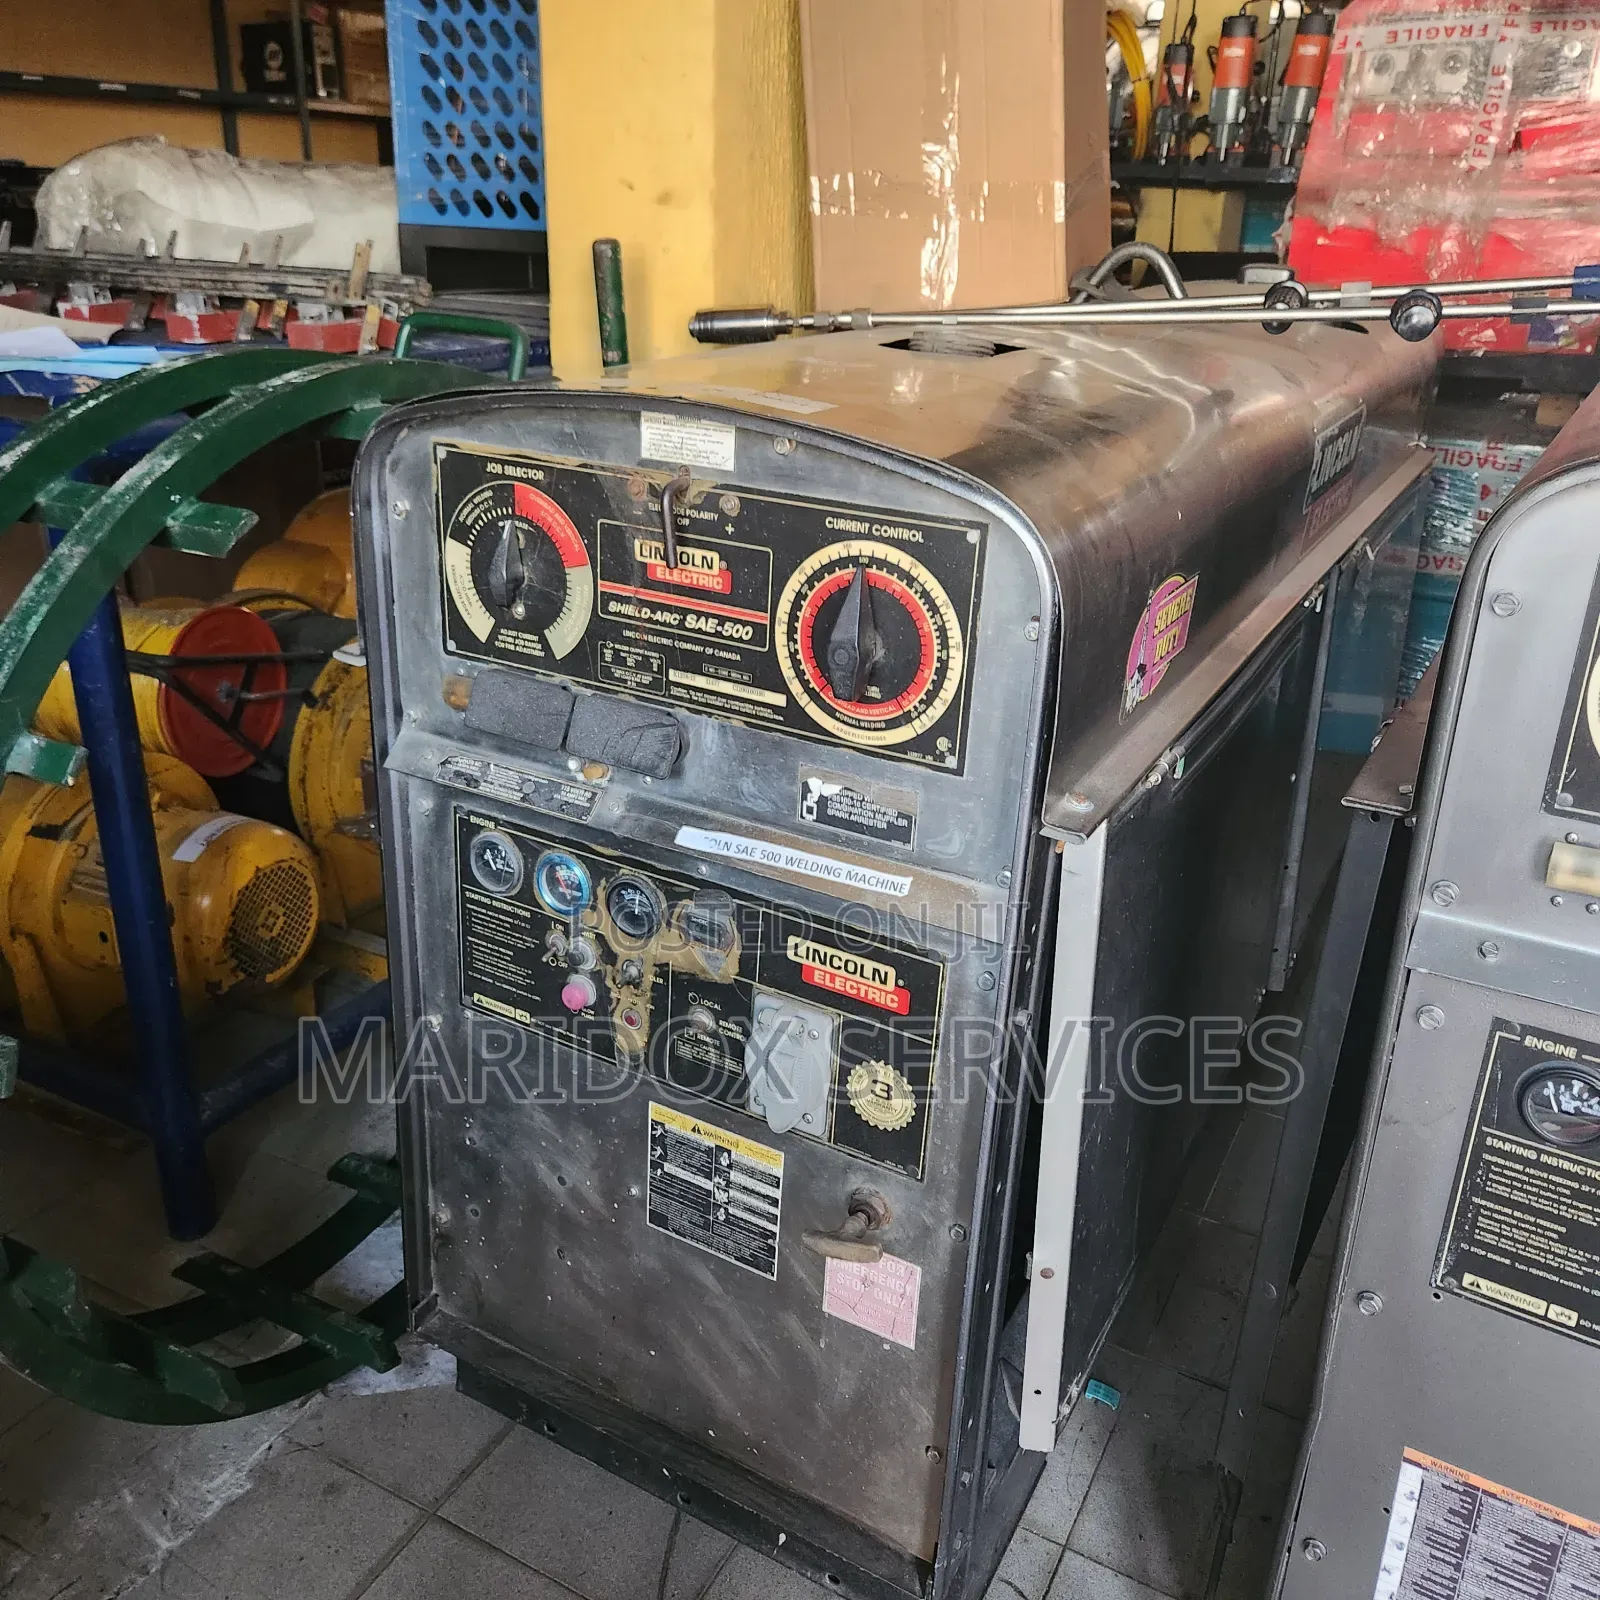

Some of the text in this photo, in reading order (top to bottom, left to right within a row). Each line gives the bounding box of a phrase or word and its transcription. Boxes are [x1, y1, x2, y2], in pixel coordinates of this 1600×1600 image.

[1386, 24, 1488, 44] FRAGILE
[1472, 63, 1507, 159] FRAGILE
[486, 462, 545, 480] JOB SELECTOR
[676, 516, 690, 527] OFF
[686, 508, 719, 522] POLARITY
[826, 517, 924, 543] CURRENT CONTROL
[638, 542, 715, 571] LINOLN
[655, 567, 724, 590] ELECTRIC
[1154, 588, 1194, 637] SEVERE
[684, 613, 754, 642] SAE-500
[648, 634, 673, 646] ELECTRIC
[674, 640, 704, 654] COMPANY
[704, 646, 714, 655] OF
[714, 648, 742, 662] CANADA
[1154, 625, 1183, 666] DUTY
[835, 711, 886, 729] NORMAL WELDING
[826, 808, 887, 830] SPARK ARRESTER
[828, 800, 908, 828] COMBINATION MUFFLER
[862, 801, 898, 816] CERTIFIED
[470, 816, 496, 830] ENGINE
[734, 841, 756, 859] SAE
[759, 849, 782, 864] 500
[784, 856, 842, 879] WELDING
[844, 869, 908, 894] MACHINE
[464, 891, 531, 918] STARTING INSTRUCTIONS
[556, 924, 564, 932] ON
[792, 942, 890, 986] LINCOLN
[813, 970, 899, 1008] ELECTRIC
[484, 1000, 513, 1014] WARNING
[700, 998, 722, 1010] LOCAL
[718, 1020, 744, 1033] REMOTE
[718, 1027, 746, 1042] CONTRO
[697, 1034, 721, 1046] REMOTE
[1524, 1035, 1578, 1059] ENGINE
[870, 1079, 894, 1101] 3
[702, 1128, 740, 1149] WARNING
[1485, 1136, 1538, 1160] STARTING
[1482, 1152, 1524, 1172] TEMPERATURE
[1524, 1167, 1548, 1179] ABOVE
[1548, 1174, 1580, 1189] FREEZING
[1472, 1196, 1566, 1234] TEMPERATURE BELOW FREEZING
[833, 1258, 912, 1296] EMERGENCY
[880, 1260, 906, 1278] FOR
[1460, 1242, 1470, 1250] TO
[1470, 1246, 1487, 1256] STOP
[1514, 1262, 1528, 1272] Turn
[1528, 1267, 1560, 1282] IGNITION
[1560, 1278, 1582, 1290] switch
[836, 1272, 870, 1293] STOP
[874, 1288, 906, 1310] ONLY
[1485, 1284, 1542, 1310] WARNING
[1430, 1459, 1568, 1520] WARNING AVERTISSEMENT
